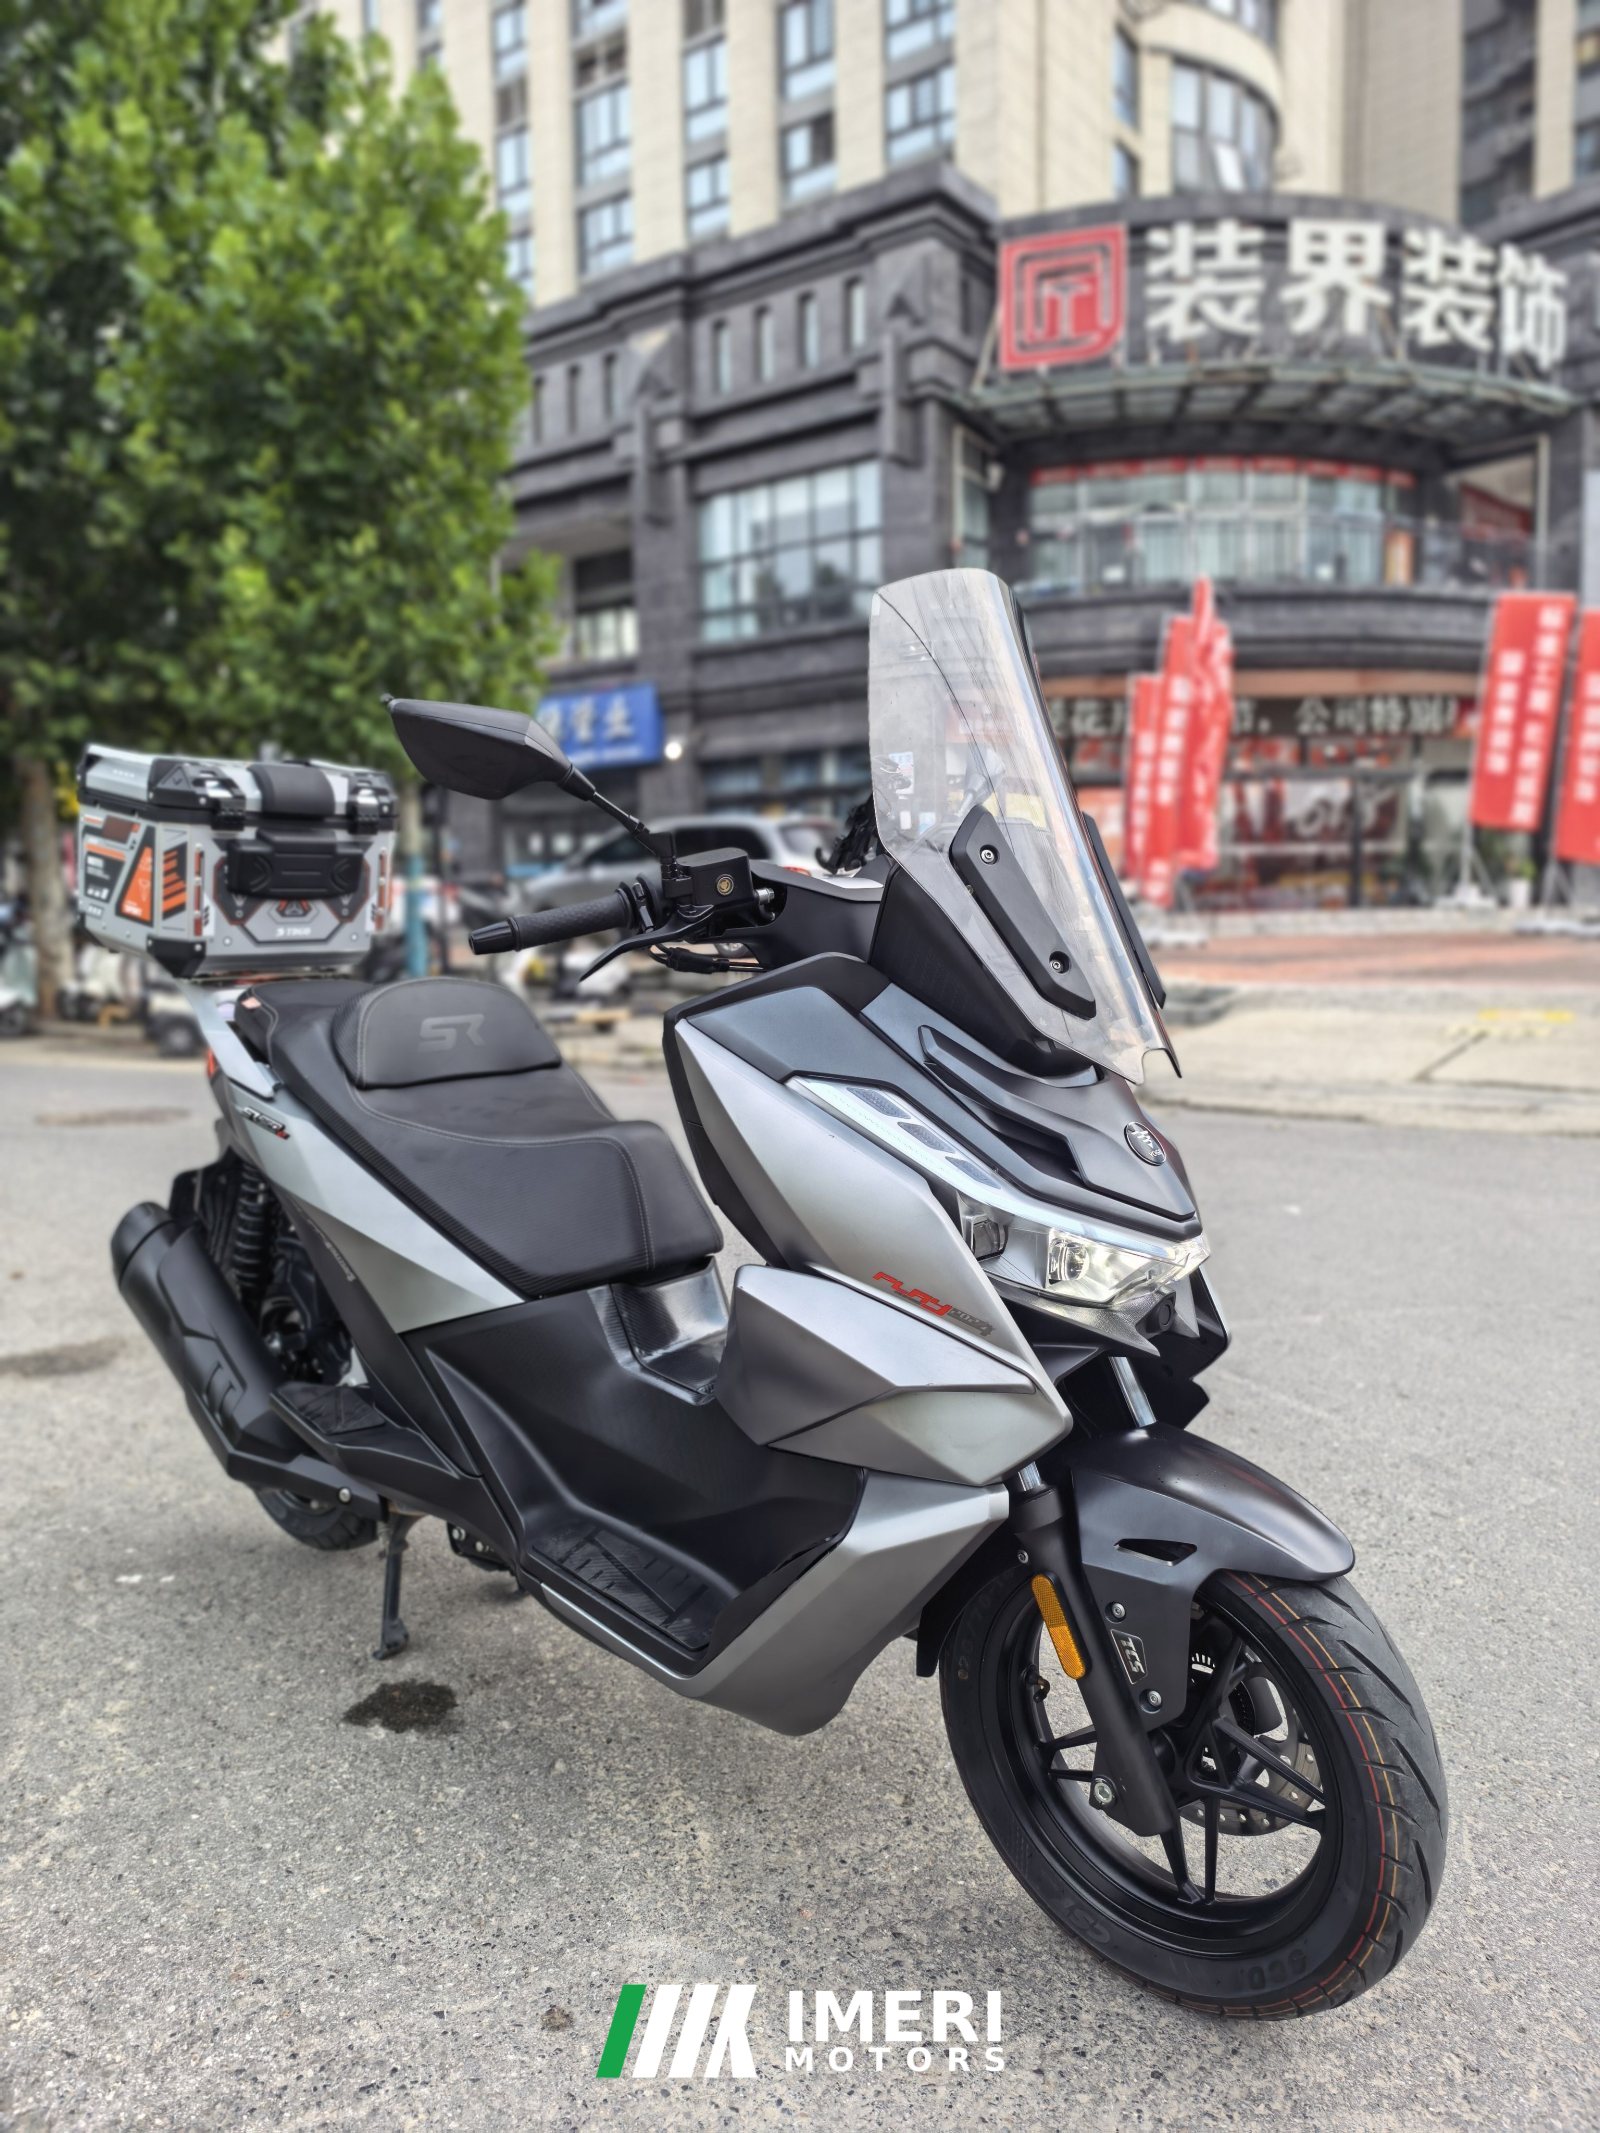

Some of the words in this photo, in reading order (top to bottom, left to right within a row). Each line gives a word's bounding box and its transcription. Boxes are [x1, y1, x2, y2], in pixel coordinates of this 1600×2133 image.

[1144, 218, 1568, 372] 装界装饰
[417, 1013, 486, 1053] SR
[1120, 1637, 1146, 1674] TCS
